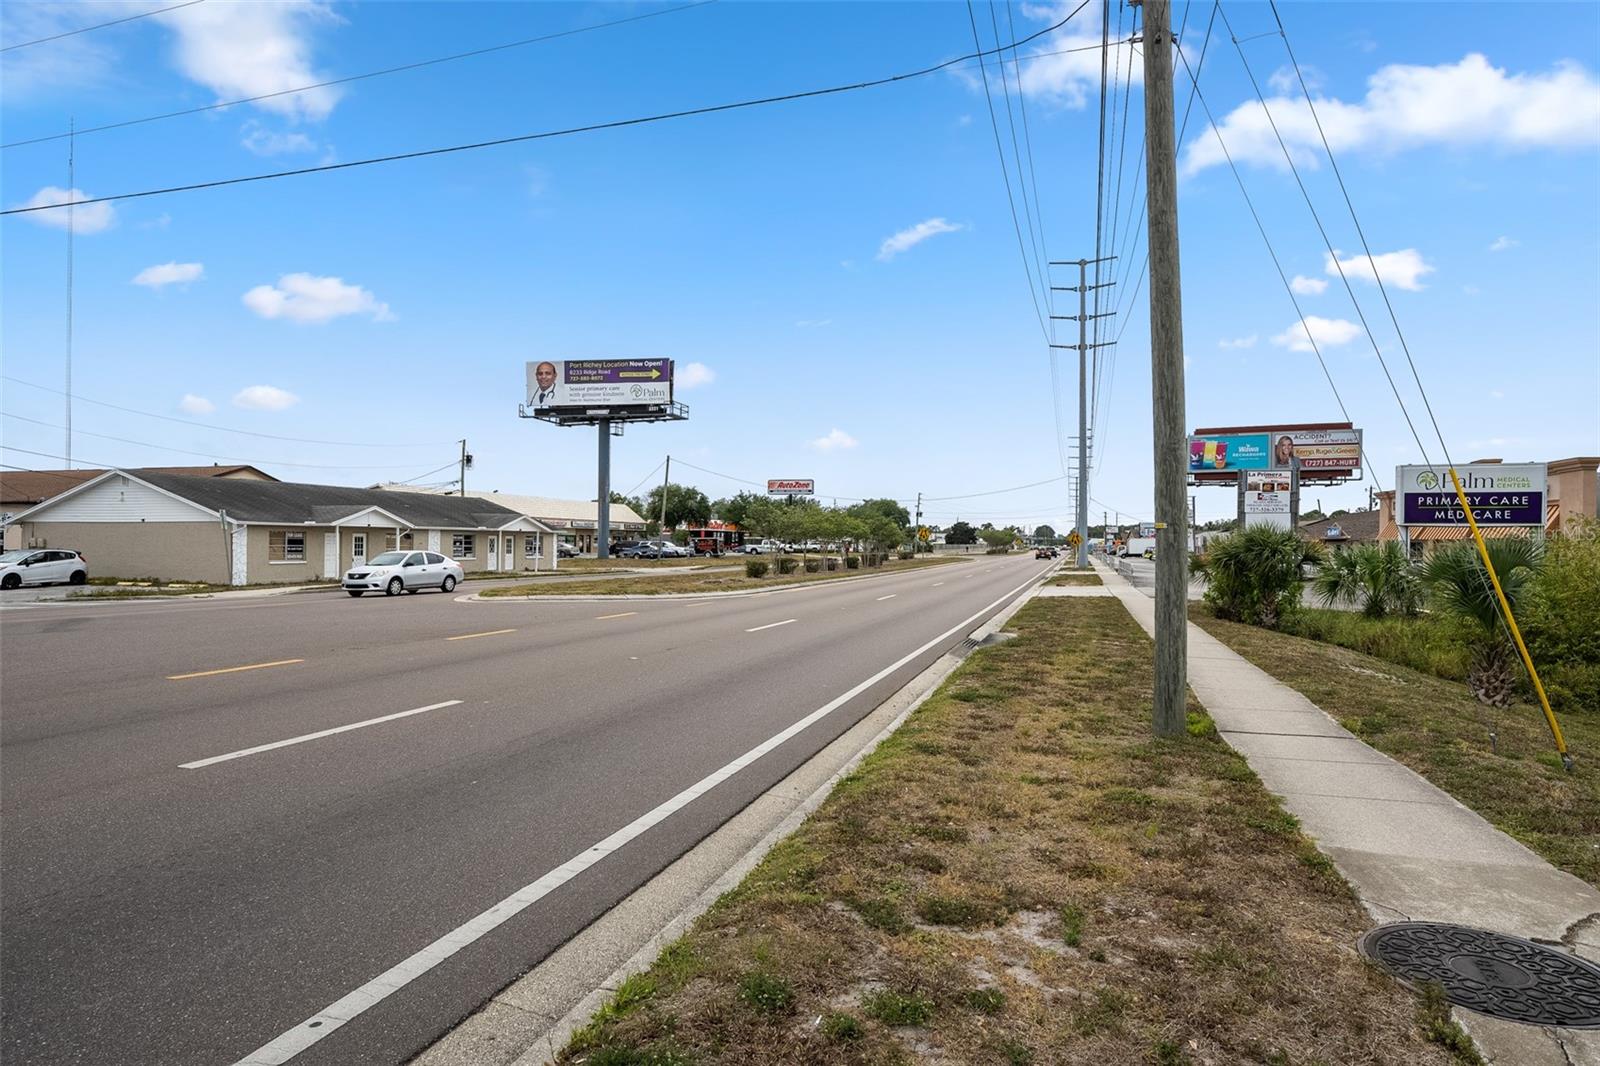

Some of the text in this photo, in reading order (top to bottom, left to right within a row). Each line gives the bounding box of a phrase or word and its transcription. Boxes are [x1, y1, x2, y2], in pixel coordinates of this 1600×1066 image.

[644, 360, 663, 368] Open!
[643, 388, 665, 397] Palm
[777, 481, 810, 489] AutoZone
[1442, 472, 1494, 489] Palm
[1418, 496, 1529, 505] PRIMARY CARE
[1434, 510, 1511, 519] MEDCARE
